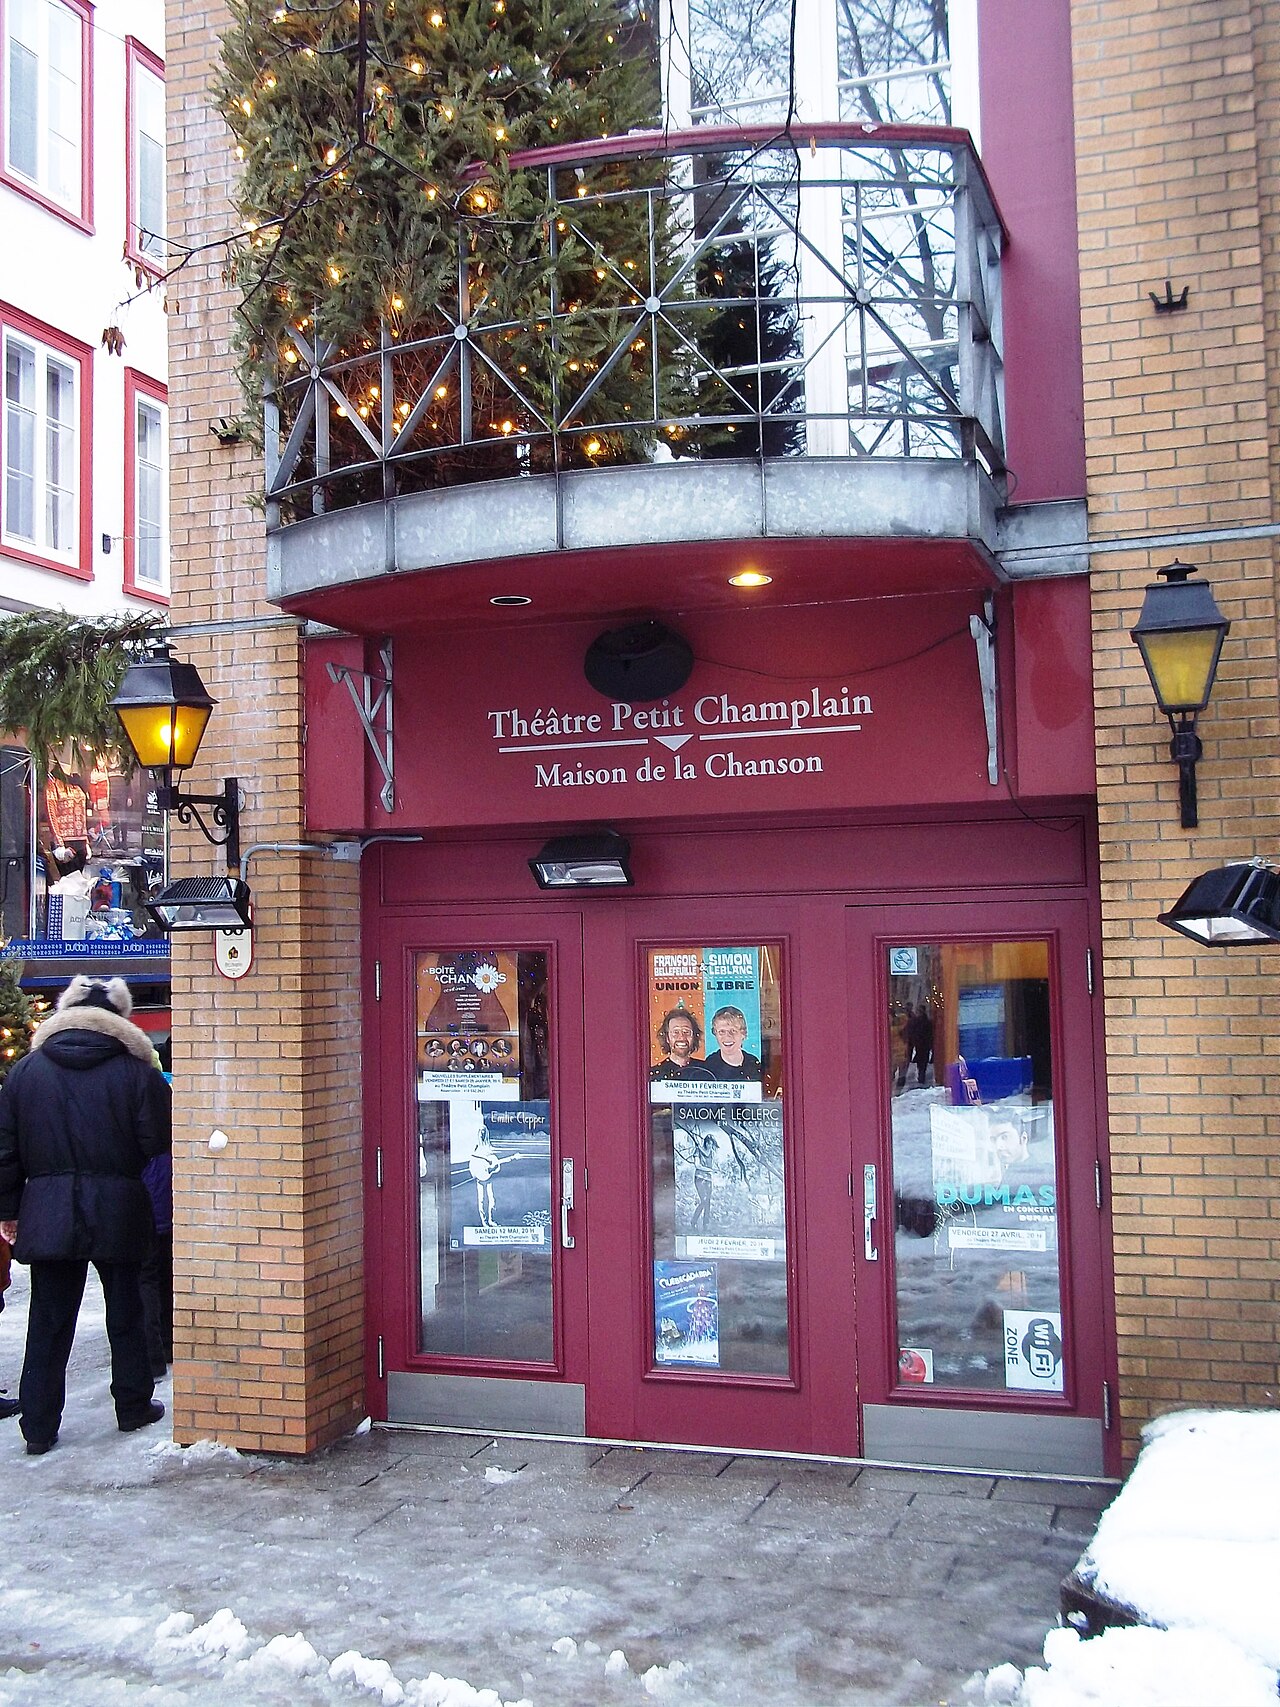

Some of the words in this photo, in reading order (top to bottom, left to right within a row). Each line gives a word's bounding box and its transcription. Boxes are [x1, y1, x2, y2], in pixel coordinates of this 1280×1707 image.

[487, 708, 602, 739] Théâtre
[611, 700, 685, 731] Petit
[694, 687, 873, 730] Champlain
[534, 762, 628, 788] Maison
[635, 757, 666, 782] de
[674, 755, 697, 780] la
[704, 753, 824, 779] Chanson
[654, 955, 697, 967] FRANÇOIS
[708, 954, 752, 965] SIMON
[429, 966, 455, 975] BOÎTE
[699, 962, 708, 971] &
[709, 965, 753, 975] LEBLANC
[655, 982, 700, 991] UNION
[706, 981, 755, 990] LIBRE
[679, 1106, 726, 1120] SALOMÉ
[731, 1107, 779, 1121] LECLERC
[516, 1112, 546, 1130] Clepper
[936, 1184, 1056, 1206] DUMAS
[951, 1229, 989, 1237] VENDREDI
[1000, 1231, 1025, 1239] AVRIL,
[1006, 1327, 1019, 1365] ZONE
